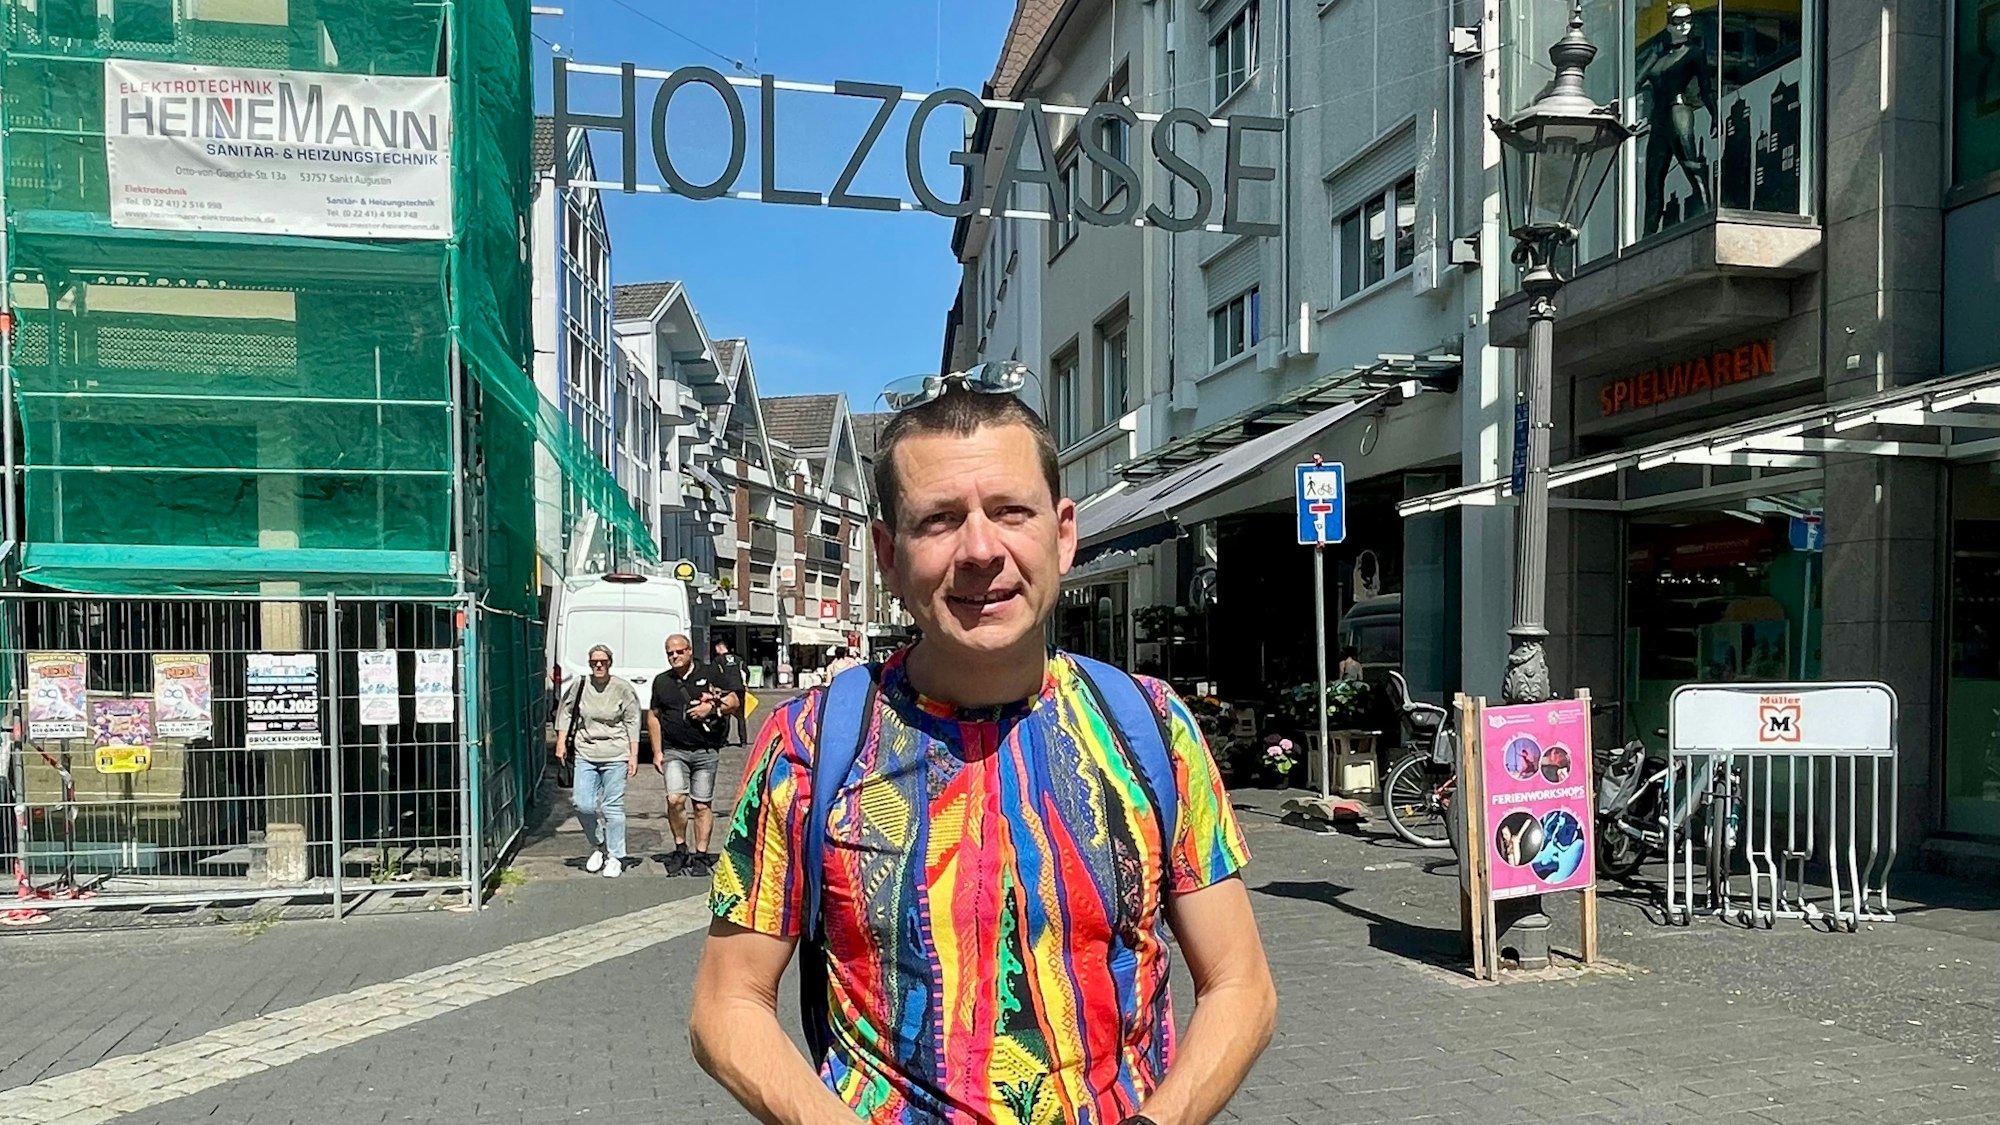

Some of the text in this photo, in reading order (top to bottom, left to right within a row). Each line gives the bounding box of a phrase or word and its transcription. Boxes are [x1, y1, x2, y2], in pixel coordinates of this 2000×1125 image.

[120, 80, 273, 95] ELEKTROTECHNIK
[120, 82, 438, 151] HEINEMANN
[206, 143, 438, 166] SANITÄR- & HEIZUNGSTECHNIK
[553, 57, 1285, 237] HOLZGASSE
[271, 171, 287, 181] 13a
[300, 173, 327, 183] 53757
[330, 174, 354, 184] Sankt
[124, 184, 187, 196] Elektrotechnik
[153, 198, 164, 207] 22
[182, 200, 187, 209] 2
[360, 198, 367, 206] &
[369, 198, 435, 208] Heizungstechnik
[1600, 338, 1777, 417] SPIELWAREN
[1760, 696, 1801, 704] Müller
[1769, 716, 1791, 732] M
[1491, 785, 1585, 805] FERIENWORKSHOPS
